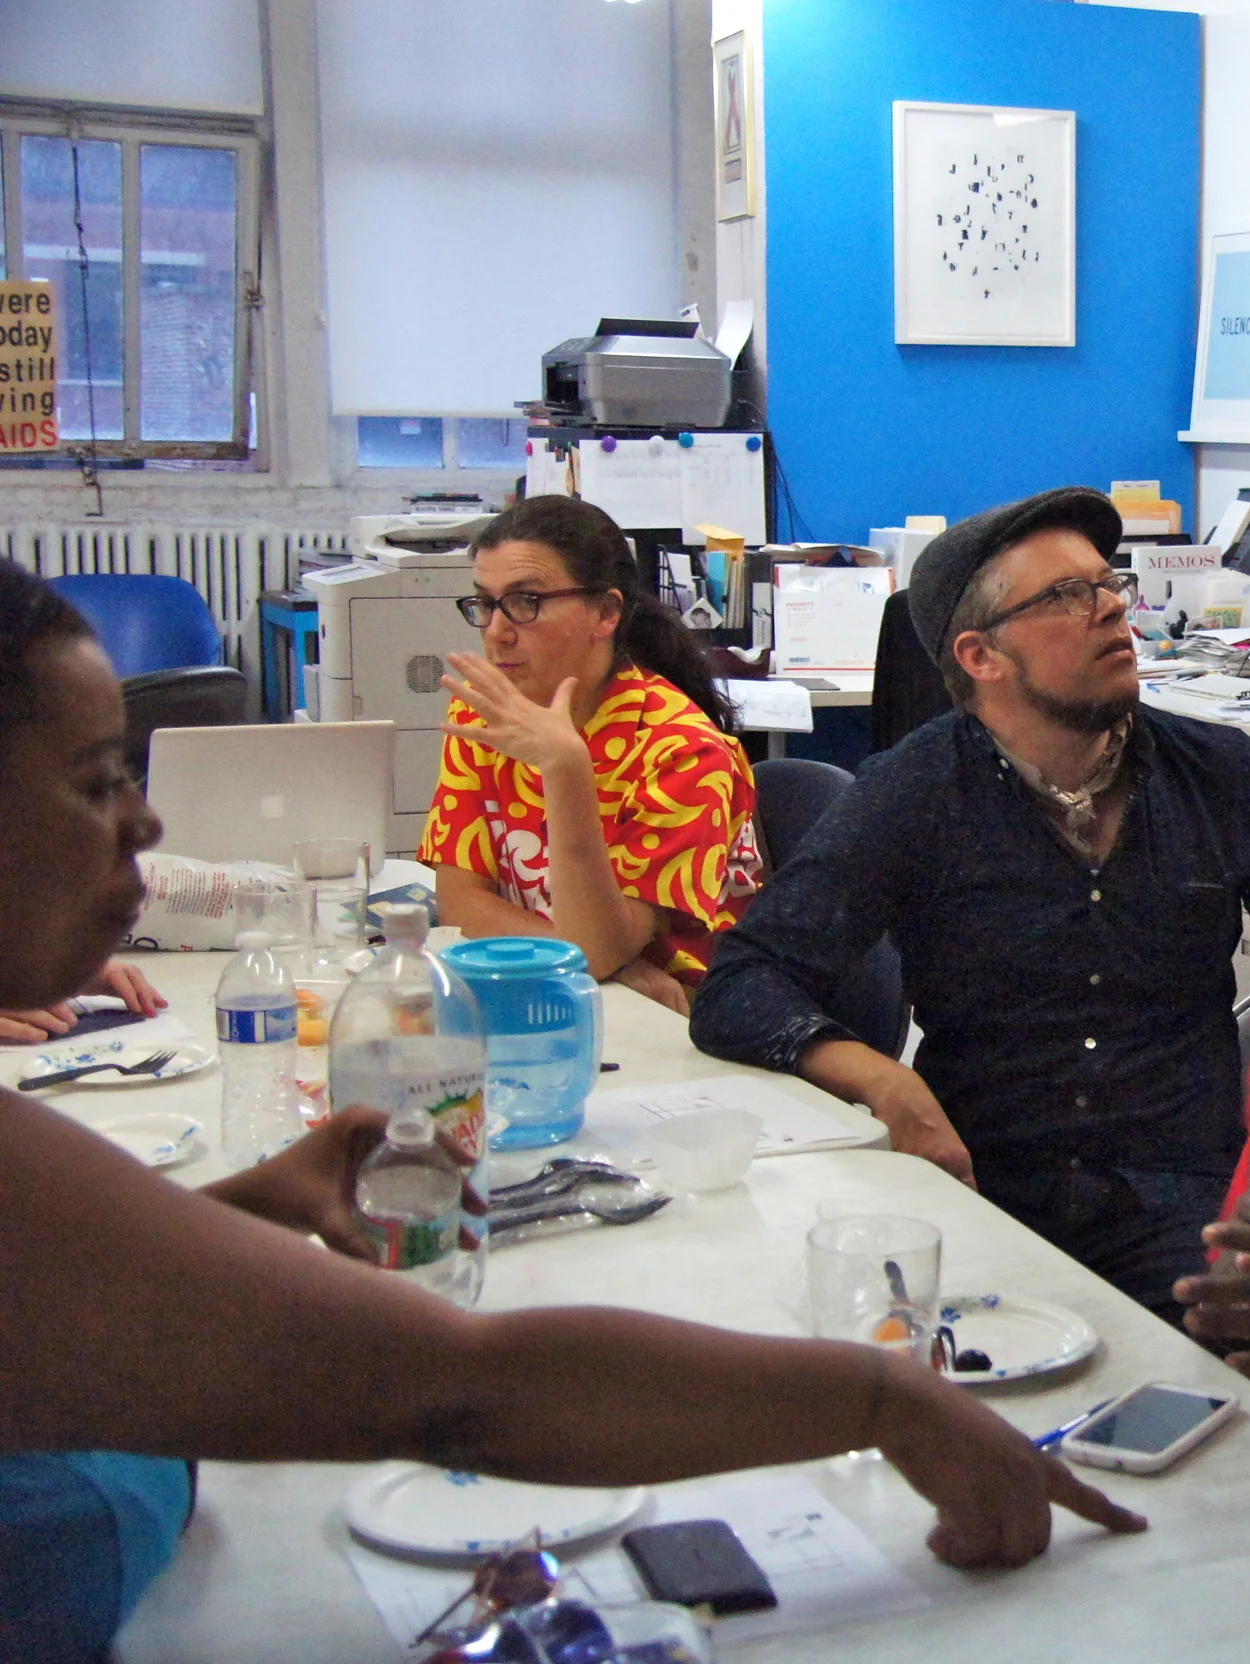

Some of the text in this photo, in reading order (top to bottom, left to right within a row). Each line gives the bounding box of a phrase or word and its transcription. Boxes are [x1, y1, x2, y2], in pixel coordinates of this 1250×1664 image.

[0, 292, 51, 315] ere
[0, 357, 55, 383] still
[0, 418, 58, 449] AIDS
[1148, 555, 1216, 570] MEMOS
